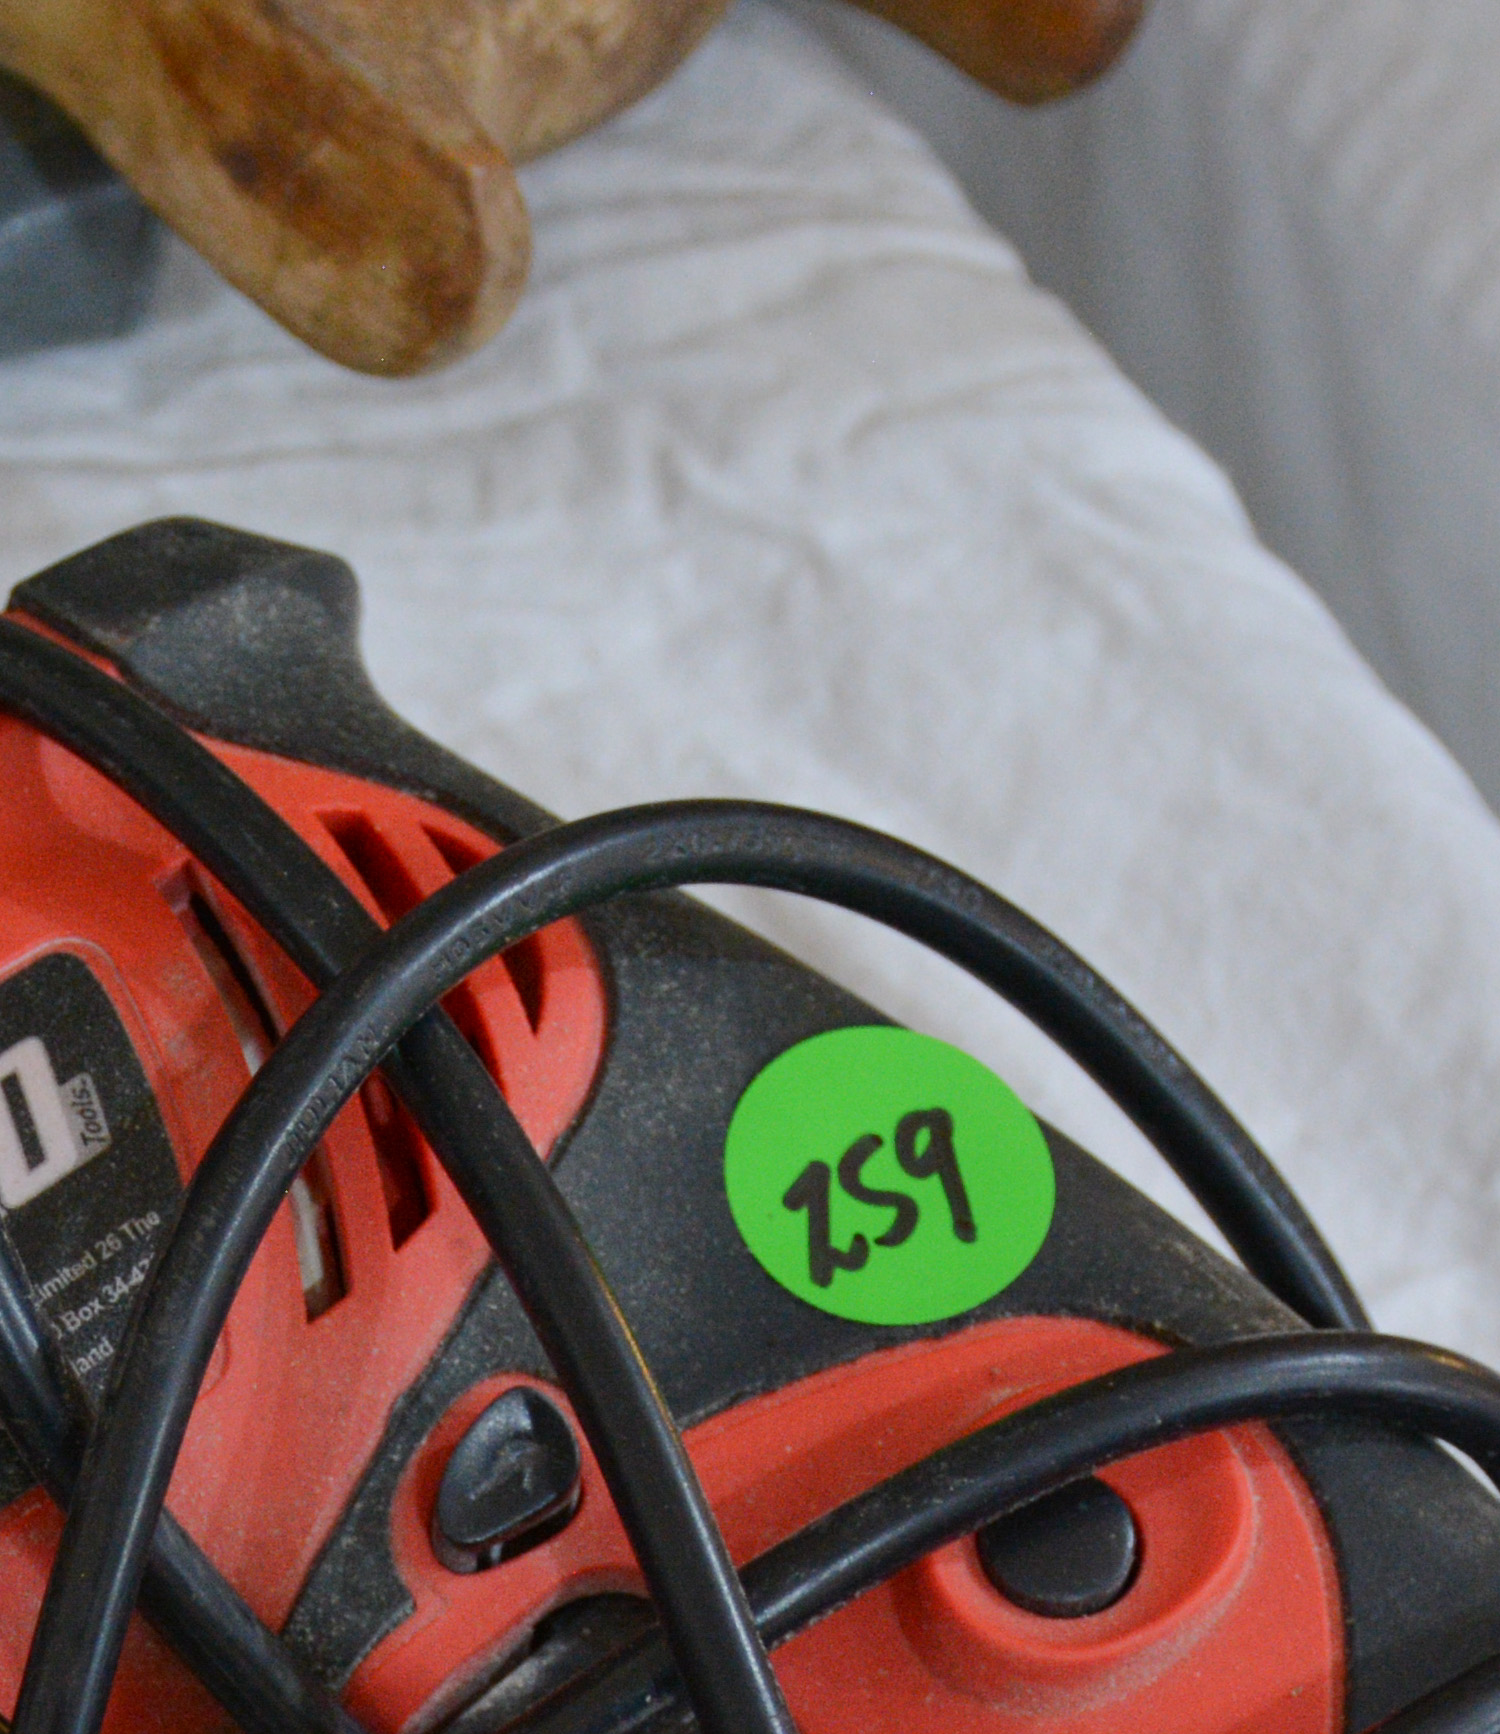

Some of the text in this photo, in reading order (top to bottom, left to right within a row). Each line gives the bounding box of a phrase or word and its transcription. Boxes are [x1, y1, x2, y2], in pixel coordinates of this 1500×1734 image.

[782, 1106, 977, 1288] 259
[117, 1210, 161, 1241] The
[58, 1296, 105, 1333] Box
